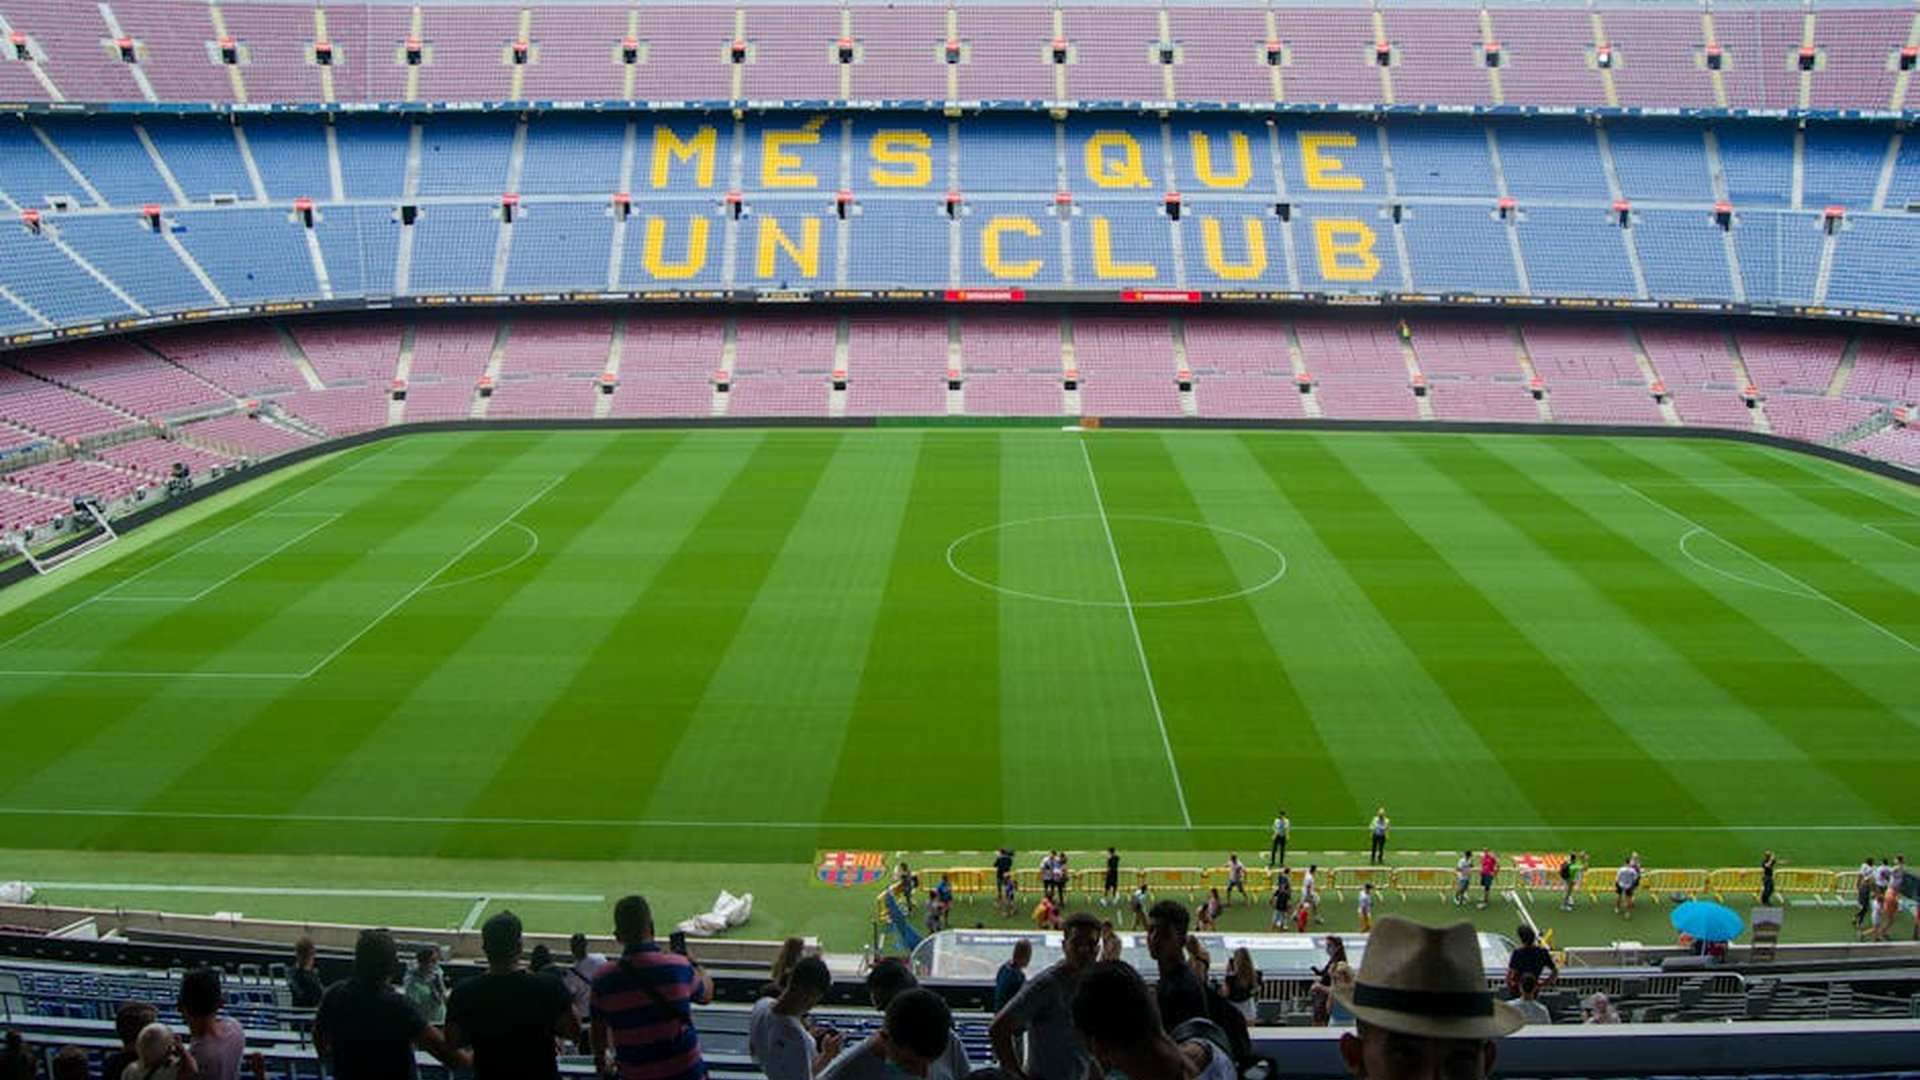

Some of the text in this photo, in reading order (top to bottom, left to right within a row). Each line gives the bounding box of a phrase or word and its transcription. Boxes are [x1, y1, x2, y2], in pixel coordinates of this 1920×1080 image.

[651, 119, 1364, 190] MÉS QUE
[642, 216, 1381, 280] UN CLUB
